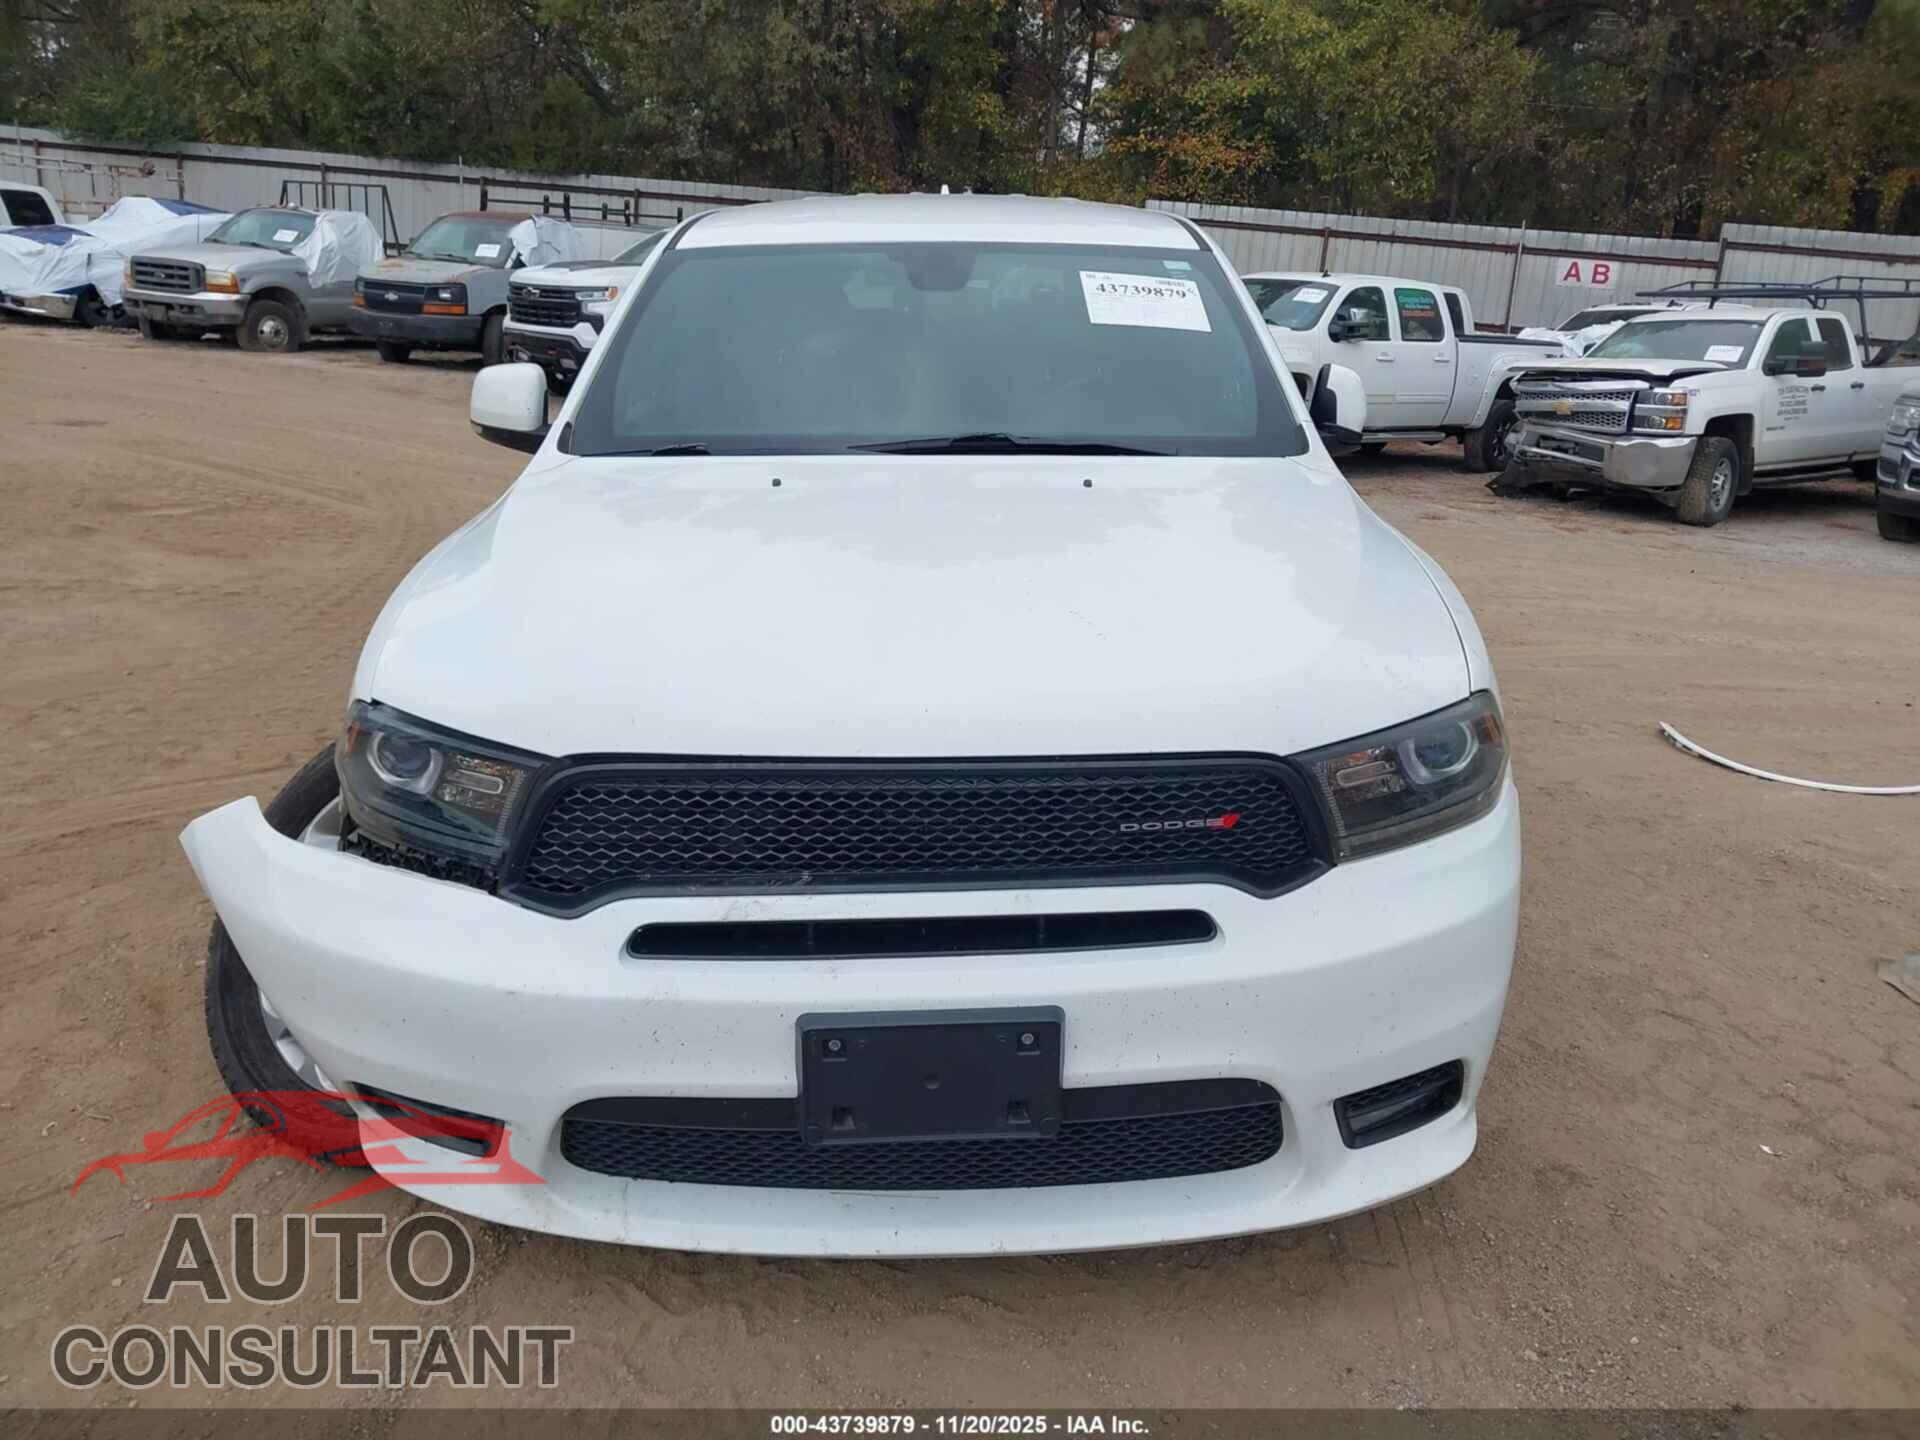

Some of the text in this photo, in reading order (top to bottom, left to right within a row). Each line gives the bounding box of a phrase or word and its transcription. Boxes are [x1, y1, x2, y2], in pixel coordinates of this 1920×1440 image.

[1563, 261, 1610, 284] A B
[1096, 283, 1187, 299] 43739879
[1120, 818, 1224, 832] DODGE
